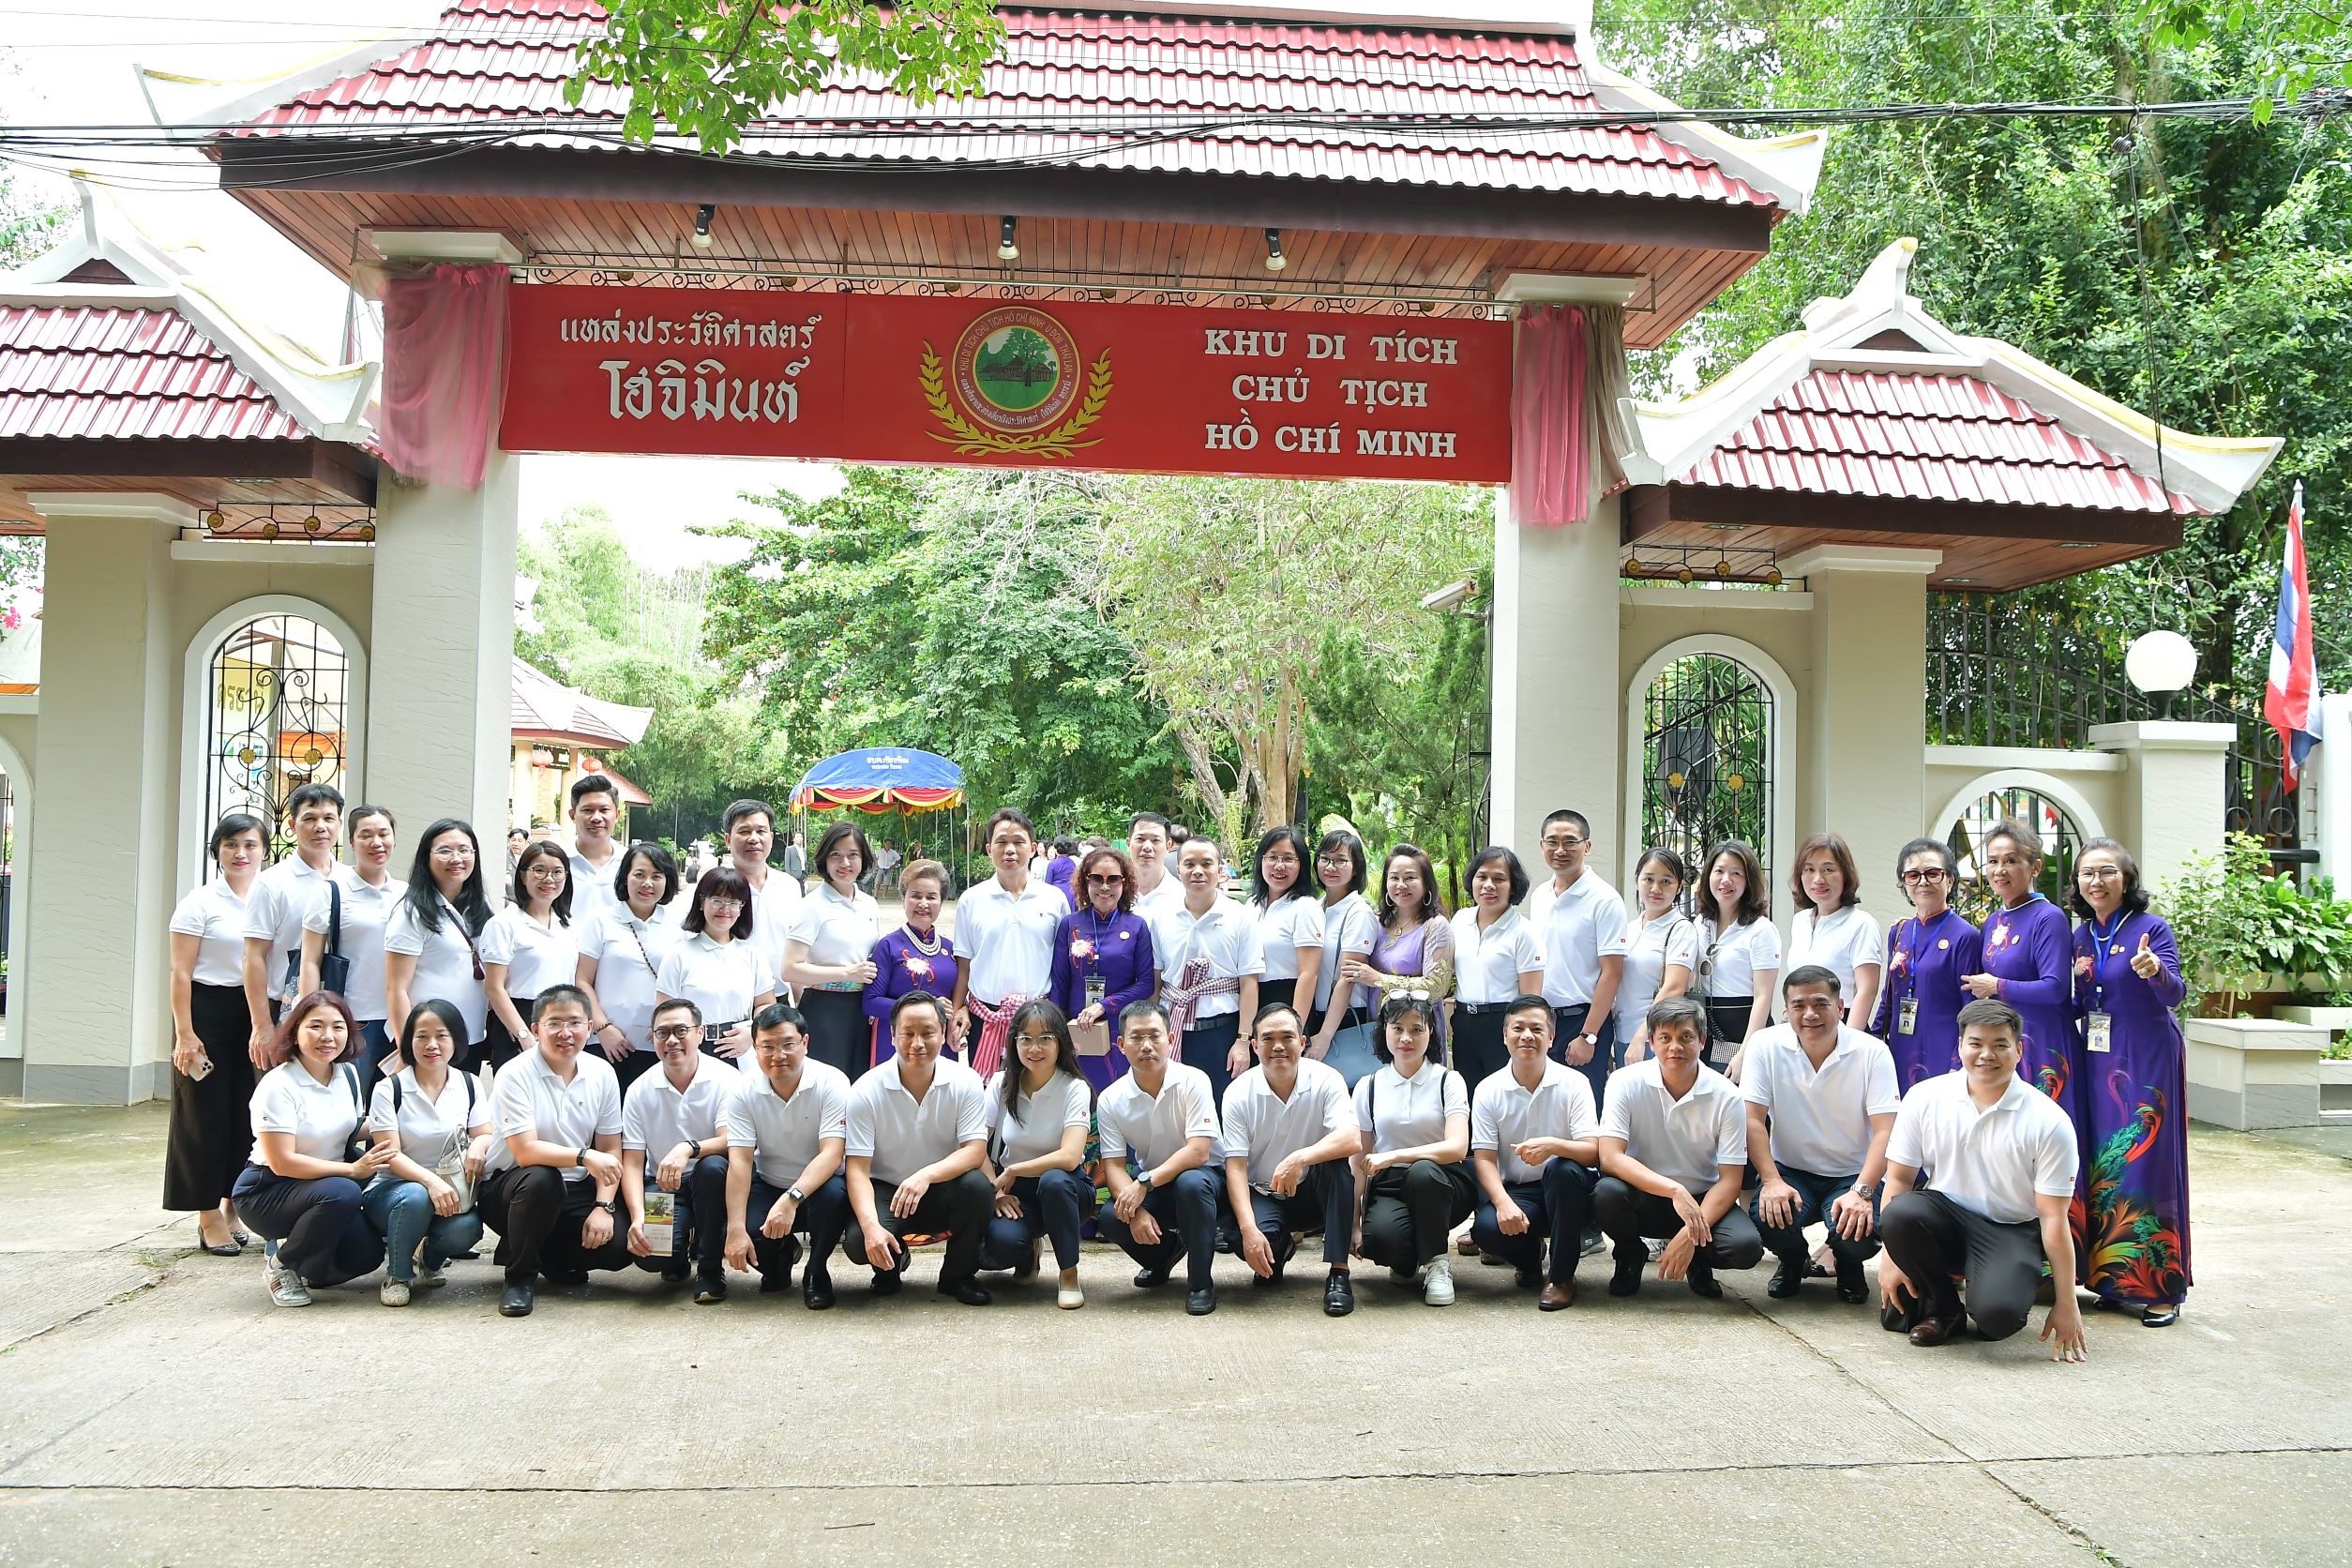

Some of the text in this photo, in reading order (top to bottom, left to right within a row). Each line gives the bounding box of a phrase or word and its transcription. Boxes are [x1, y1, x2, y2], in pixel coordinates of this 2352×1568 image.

[561, 308, 822, 350] แหล่งประวัติศาสตร์
[959, 355, 969, 371] KHU
[1016, 311, 1028, 323] CHÍ
[1029, 314, 1046, 328] MINH
[1063, 359, 1073, 373] LAN
[1204, 329, 1458, 365] KHU DI TÍCH
[598, 355, 811, 424] โฮจิมินห์
[1231, 367, 1428, 415] CHỦ TỊCH
[1204, 407, 1457, 458] HỒ CHÍ MINH
